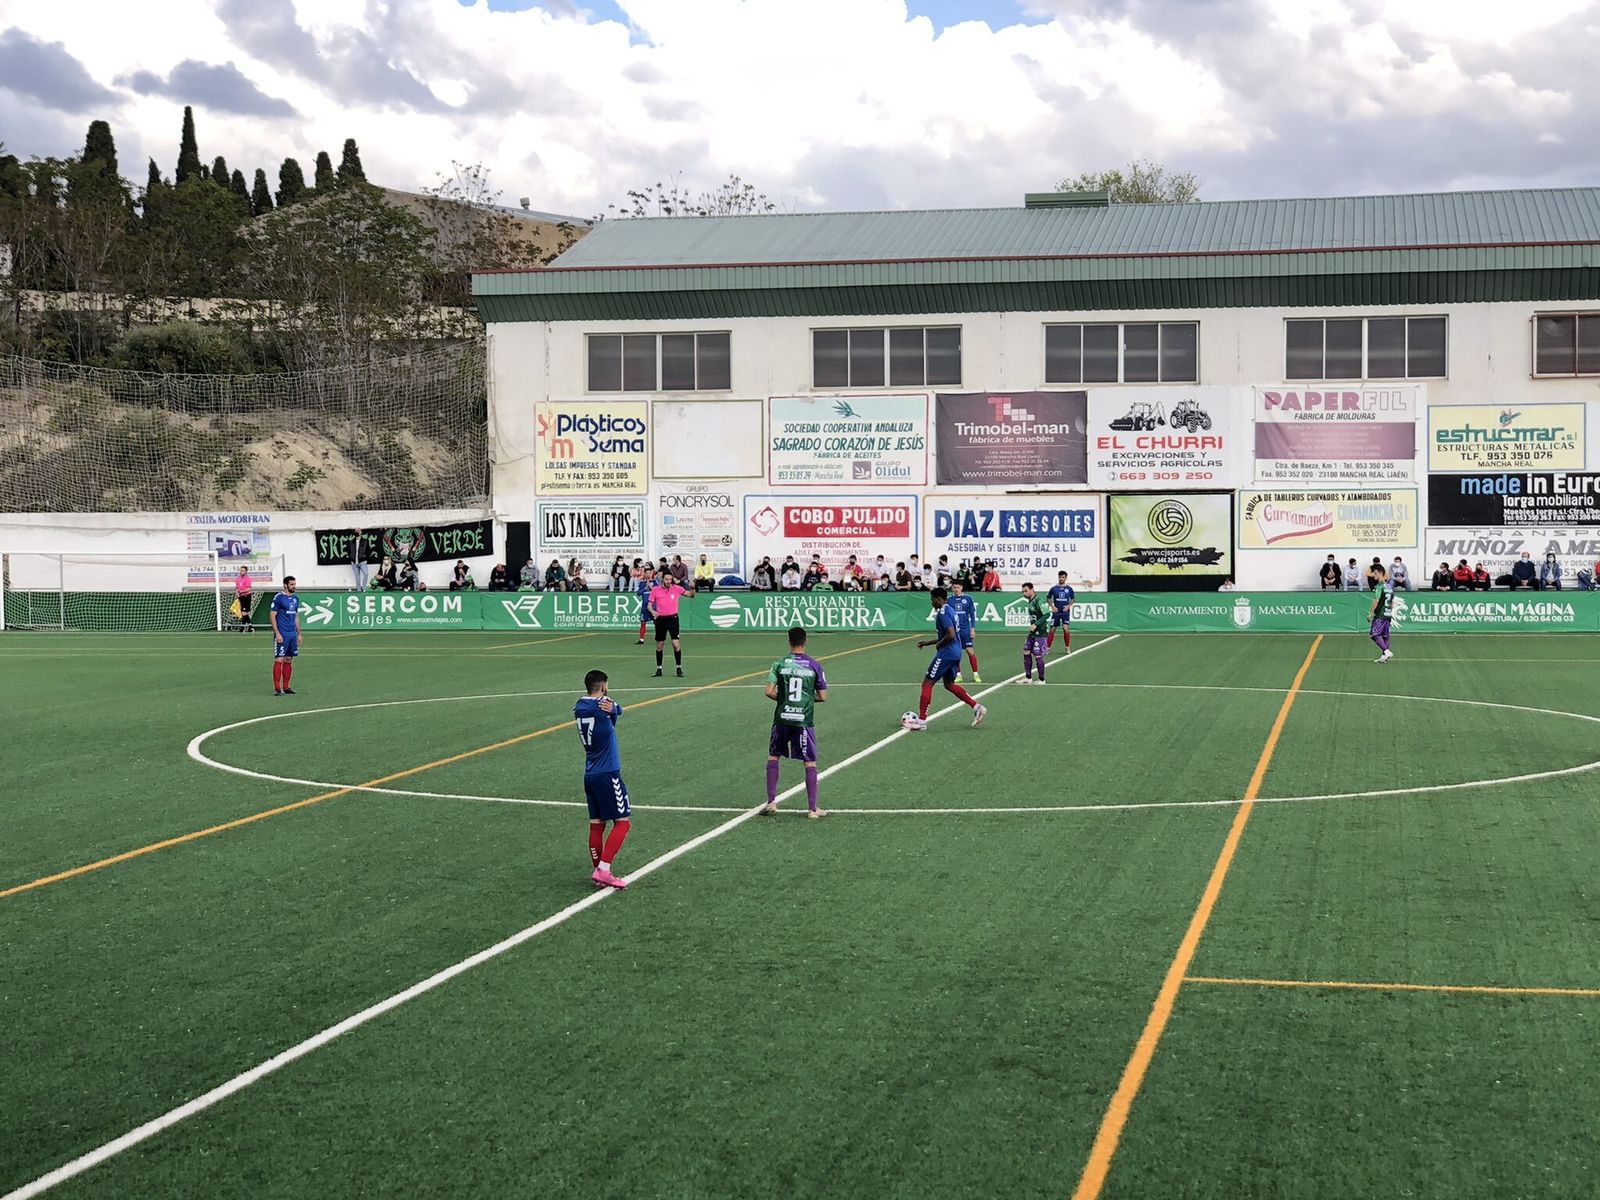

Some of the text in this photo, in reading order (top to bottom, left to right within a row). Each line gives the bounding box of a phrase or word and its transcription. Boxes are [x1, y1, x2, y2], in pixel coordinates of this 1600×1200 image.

[1264, 391, 1407, 411] PAPERFIL
[557, 414, 646, 436] Plásticos
[784, 422, 913, 433] SOCIEDAD COOPERATIVA ANDALUZA
[954, 422, 1070, 435] Trimobel-man
[589, 435, 644, 453] Sema
[773, 433, 924, 451] SAGRADO CORAZÓN DE JESÚS
[1097, 435, 1223, 450] EL CHURRI
[1437, 442, 1575, 452] ESTRUCTURAS METALICAS
[1487, 452, 1507, 460] 953
[1510, 452, 1530, 460] 350
[1533, 451, 1553, 460] 076
[1160, 459, 1223, 467] AGRÍCOLAS
[588, 472, 600, 480] 953
[875, 466, 911, 477] Olidul
[962, 469, 1062, 478] www.trimobel-man.com
[1120, 472, 1213, 480] 663 309 250
[1460, 474, 1521, 495] made
[1526, 473, 1547, 494] in
[660, 495, 735, 508] FONCRYSOL
[1245, 494, 1263, 521] FABRICA
[1264, 493, 1272, 501] DE
[1274, 493, 1305, 501] TABLEROS
[1306, 493, 1339, 501] CURVADOS
[1347, 493, 1392, 501] ATAMBORADOS
[1502, 494, 1594, 508] Torga mobiliario
[218, 515, 271, 523] MOTORFRAN
[789, 508, 906, 525] COBO PULIDO
[546, 512, 566, 538] LOS
[934, 510, 1092, 538] DIAZ ASESORES
[817, 527, 876, 535] COMERCIAL
[320, 527, 484, 560] FREE VERDE
[802, 540, 851, 549] DISTRIBUCIÓN
[948, 541, 986, 552] ASESORÍA
[989, 543, 994, 552] Y
[997, 541, 1028, 552] GESTIÓN
[1434, 536, 1525, 556] MUÑOZ
[1140, 549, 1200, 558] www.cjsports.es
[1010, 557, 1030, 568] 247
[1035, 557, 1058, 568] 840
[346, 595, 462, 613] SERCOM
[765, 596, 865, 608] RESTAURANTE
[1409, 600, 1575, 616] AUTOWAGEN MÁGINA
[1148, 605, 1335, 615] AYUNTAMIENTO MANCHA REAL
[349, 613, 463, 627] viajes www.sercomviajes.com
[554, 614, 619, 622] interiorismo &
[743, 607, 887, 628] MIRASIERRA
[789, 677, 803, 702] 9
[576, 717, 595, 746] 17
